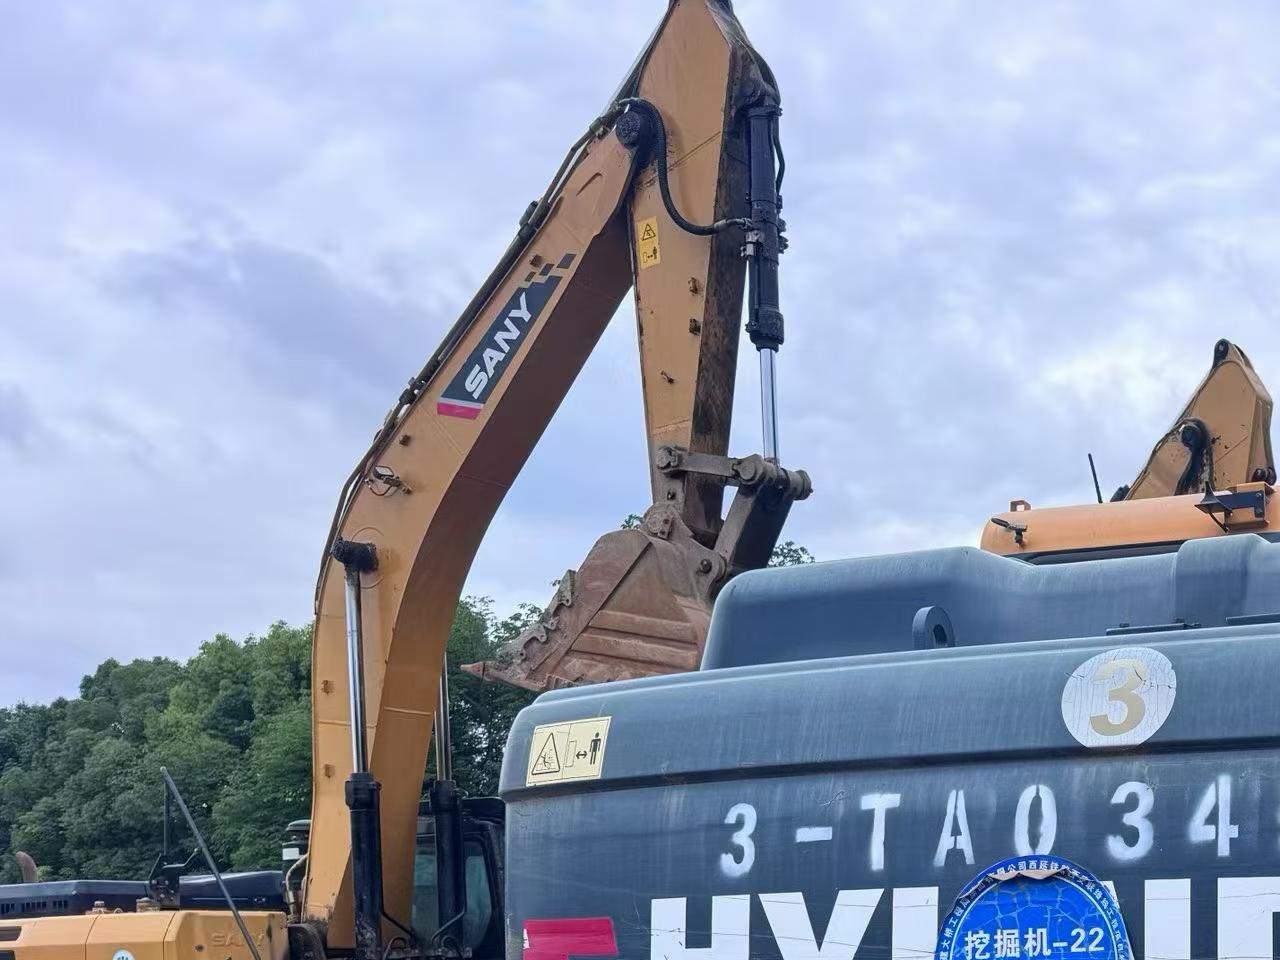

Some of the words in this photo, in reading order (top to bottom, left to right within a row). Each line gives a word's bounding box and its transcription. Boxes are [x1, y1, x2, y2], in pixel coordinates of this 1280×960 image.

[463, 291, 533, 399] SANY
[1089, 657, 1148, 737] 3
[964, 926, 1105, 960] 挖掘机-22
